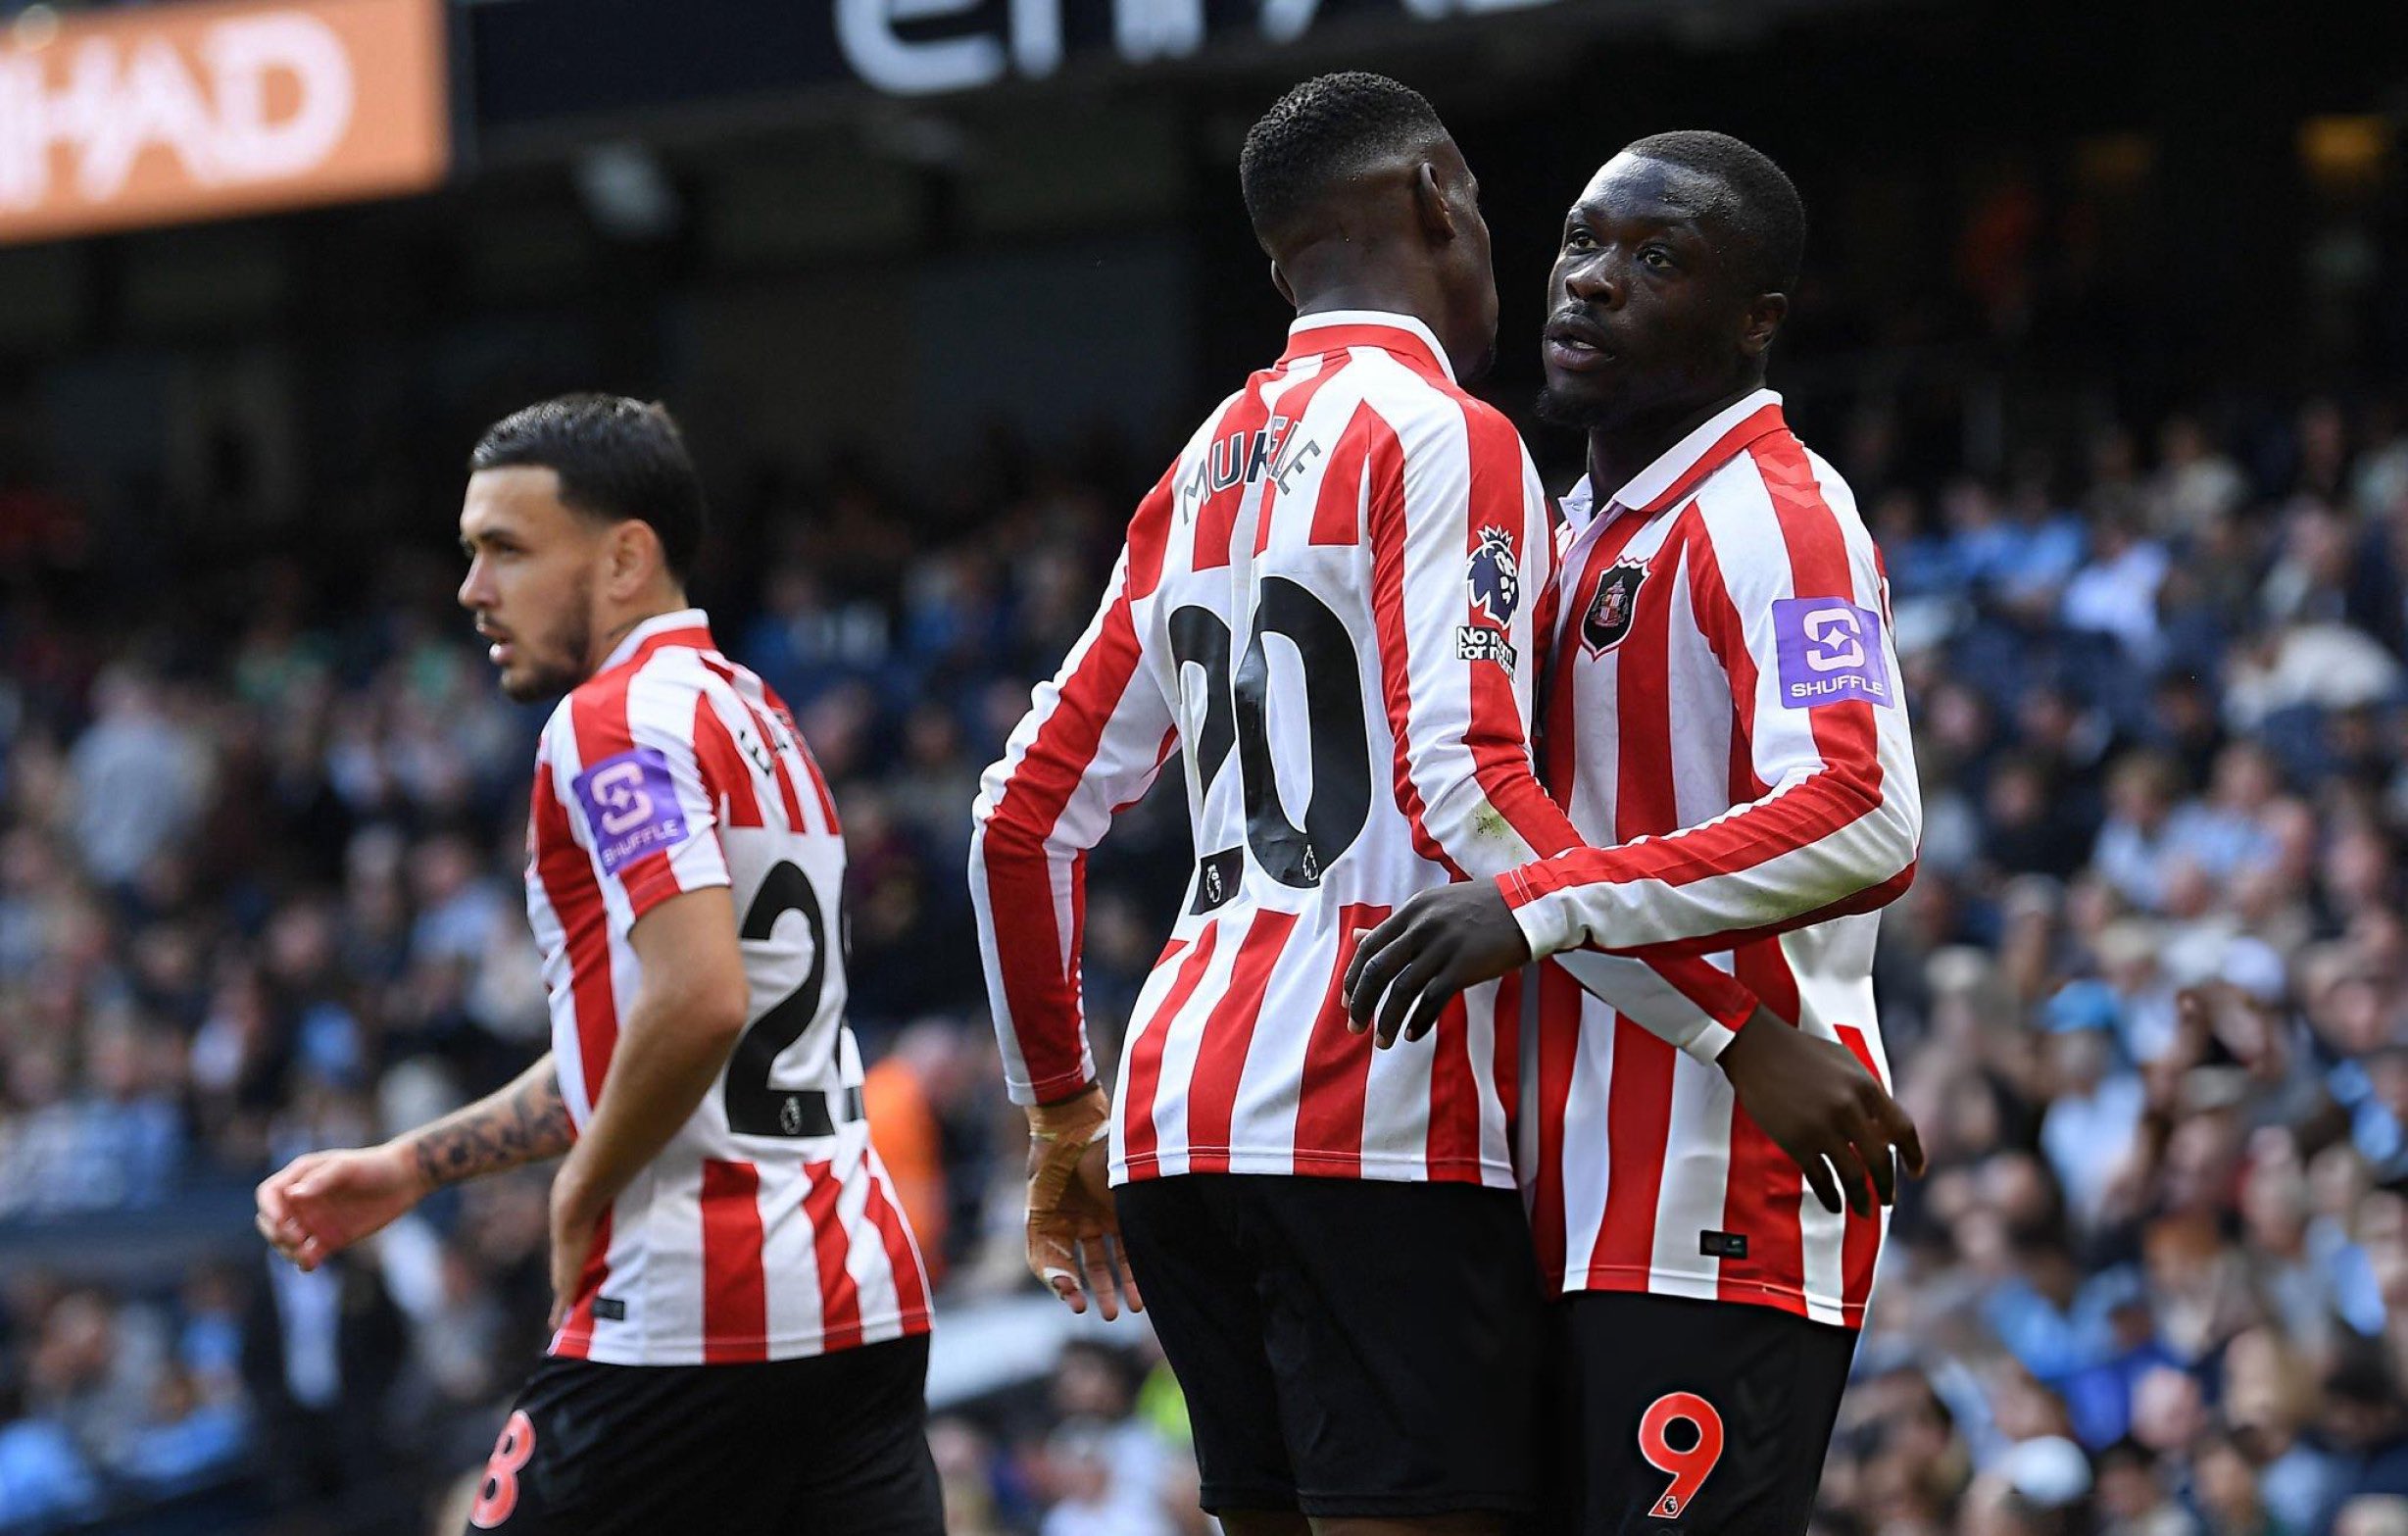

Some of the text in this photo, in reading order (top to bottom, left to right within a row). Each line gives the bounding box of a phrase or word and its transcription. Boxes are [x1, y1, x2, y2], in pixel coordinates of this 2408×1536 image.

[1457, 626, 1488, 645] No
[1791, 674, 1885, 698] SHUFFLE
[1169, 575, 1372, 916] 20
[601, 818, 680, 867] SHUFFLE
[724, 860, 867, 1138] 2
[469, 1409, 537, 1530] 8
[1638, 1391, 1724, 1519] 9
